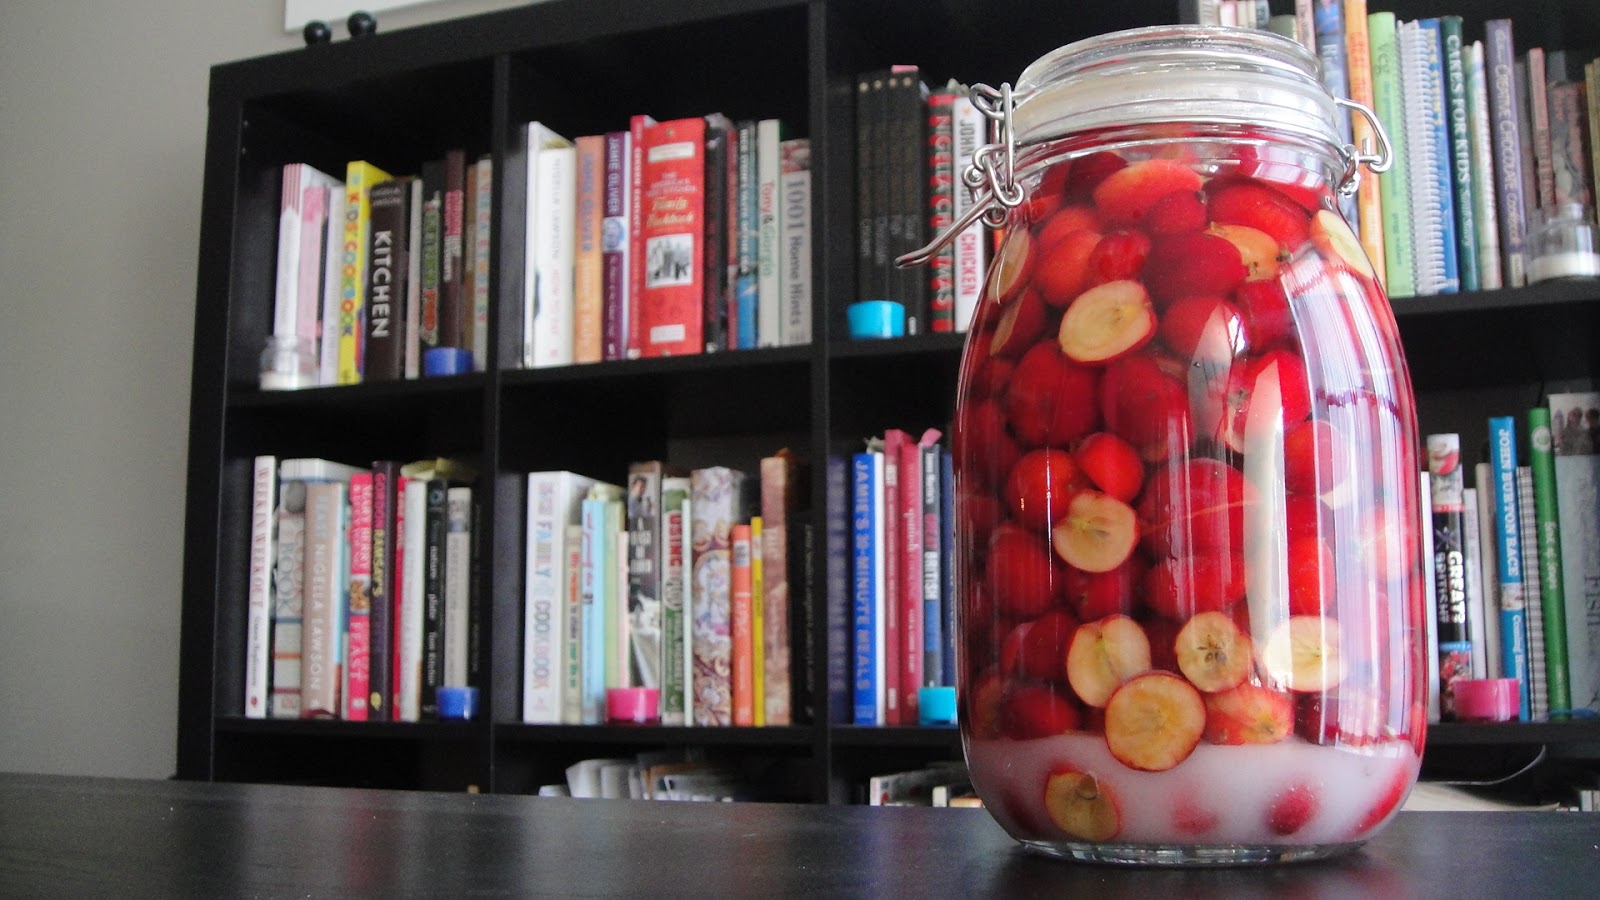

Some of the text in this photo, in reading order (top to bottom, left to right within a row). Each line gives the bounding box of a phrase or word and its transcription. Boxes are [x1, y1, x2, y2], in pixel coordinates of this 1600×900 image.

[1376, 41, 1393, 77] veg
[960, 119, 976, 157] JOHN
[1446, 34, 1470, 183] CAKES FOR KIDS
[608, 136, 620, 214] JAMIE OLIVER
[936, 116, 952, 193] NIGELLA
[371, 230, 392, 338] KITCHEN
[785, 179, 806, 326] 1001 Home Hints
[960, 233, 977, 296] CHICKEN
[339, 241, 358, 337] COOKBOOK
[374, 472, 386, 529] GORDON
[855, 461, 870, 530] JAMIE'S
[1498, 429, 1518, 577] JOHN BURTON RACE
[252, 466, 269, 609] WEEK IN WEEK OUT
[371, 529, 384, 597] RAMSAY'S
[428, 545, 438, 580] nature
[534, 521, 553, 578] FAMILY
[669, 513, 682, 567] USING
[277, 542, 294, 613] BOOK
[311, 544, 327, 610] NIGELLA
[427, 593, 437, 621] plate
[856, 534, 870, 625] 30-MINUTE
[923, 551, 939, 600] BRITISH
[1447, 550, 1465, 614] GREAT
[310, 618, 325, 690] LAWSON
[533, 601, 552, 690] COOKBOOK
[856, 629, 870, 691] MEALS
